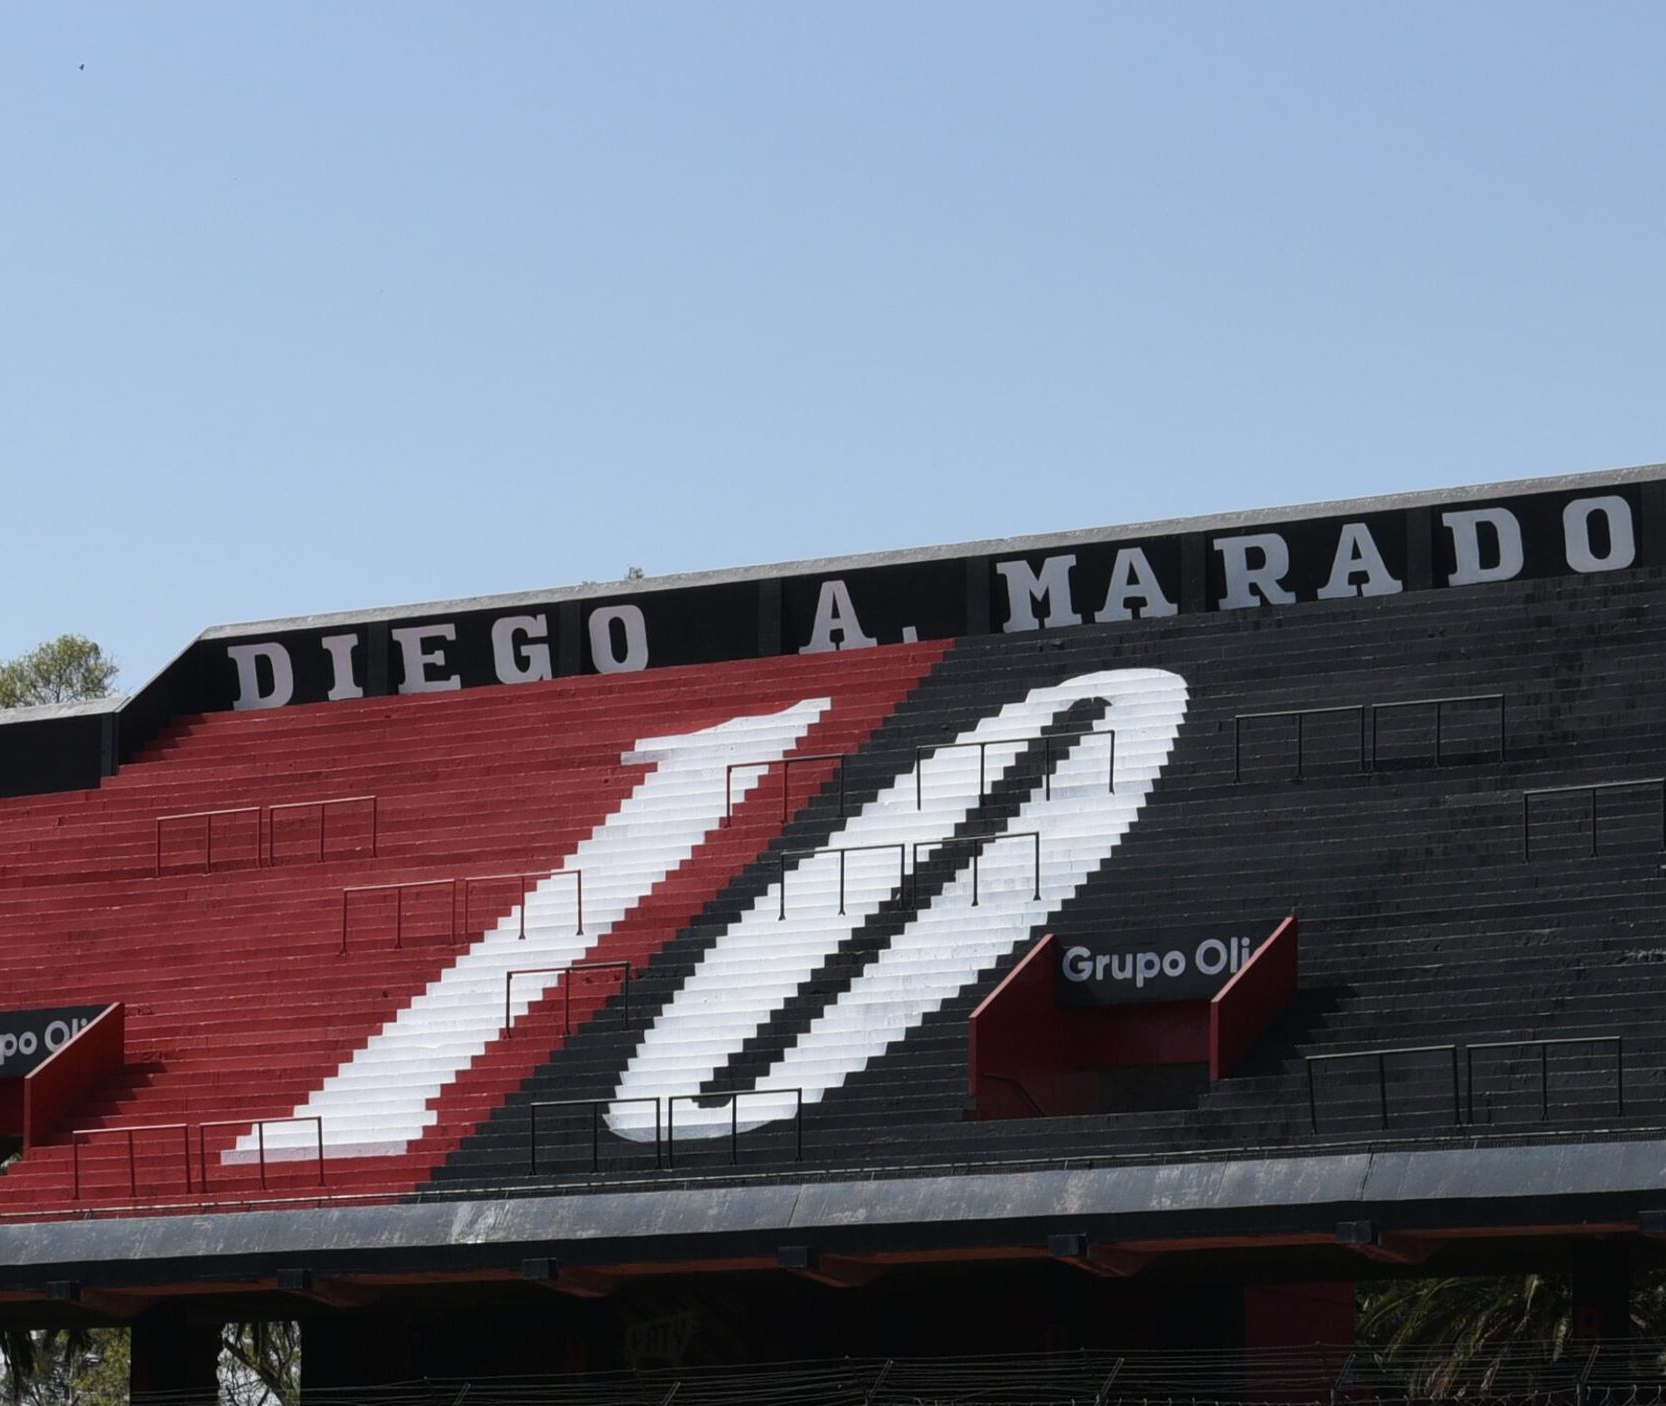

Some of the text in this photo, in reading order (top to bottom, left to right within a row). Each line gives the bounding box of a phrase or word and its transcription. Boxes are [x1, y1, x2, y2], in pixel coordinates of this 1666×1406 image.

[227, 604, 649, 711] DIEGO
[798, 580, 918, 655] A.
[220, 668, 1188, 1166] 10
[1062, 945, 1186, 988] Grupo
